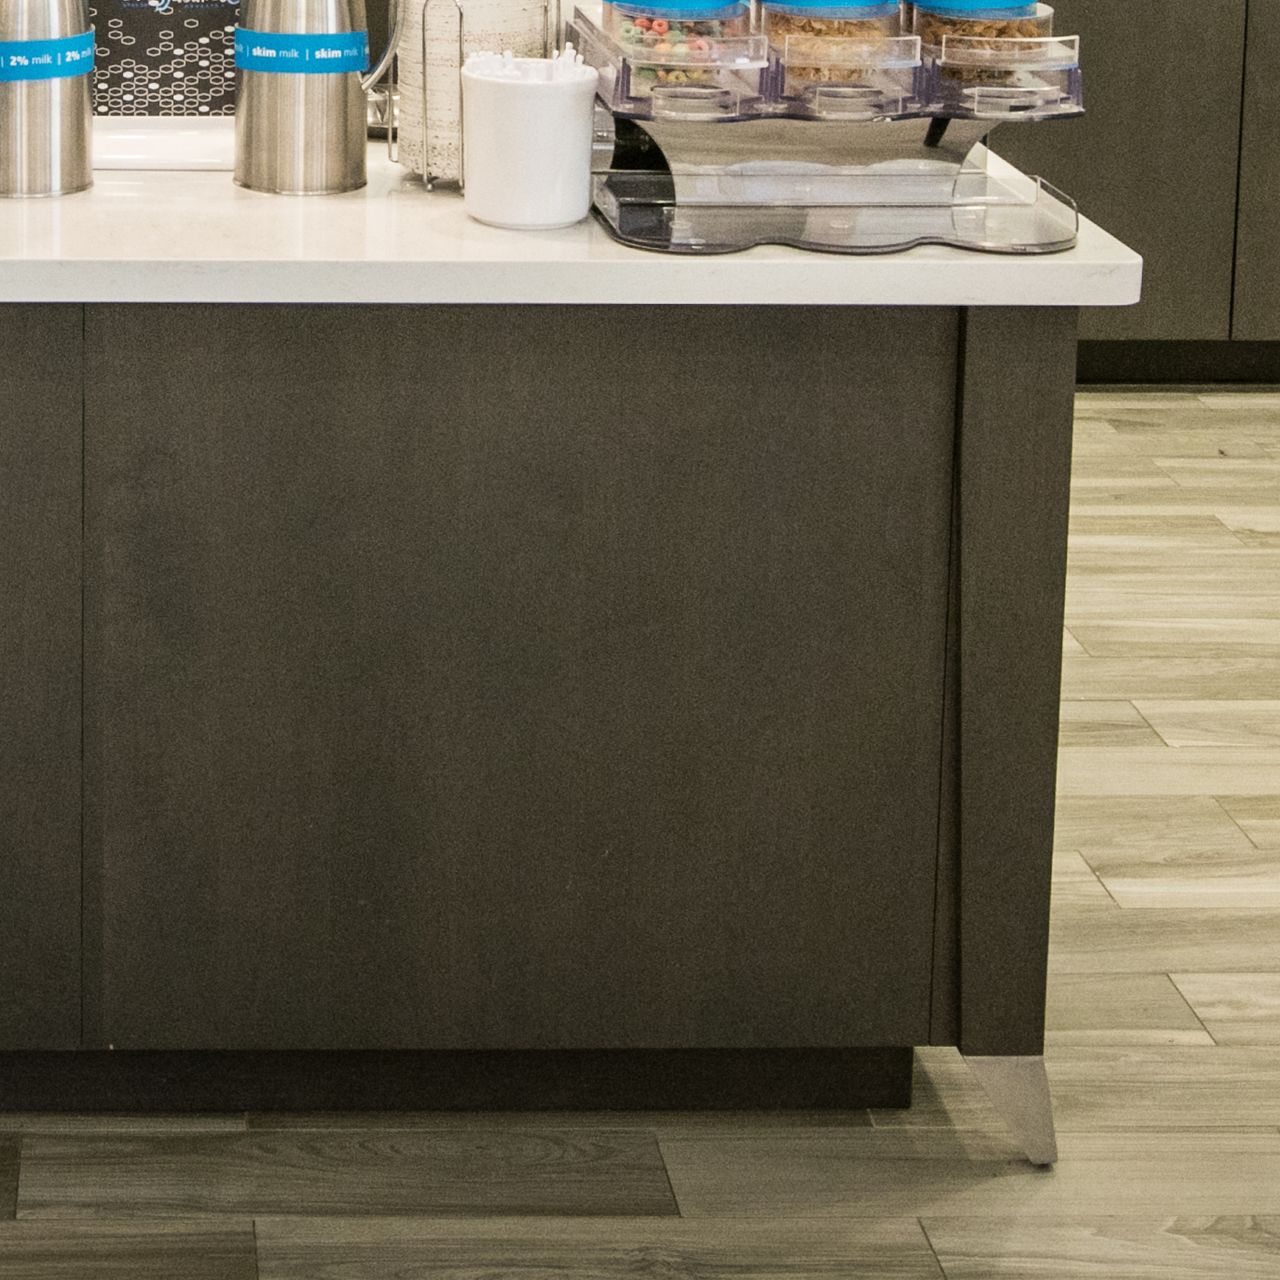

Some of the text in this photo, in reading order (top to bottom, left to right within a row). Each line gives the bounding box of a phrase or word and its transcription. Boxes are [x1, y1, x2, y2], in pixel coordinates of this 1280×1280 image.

[10, 55, 28, 66] 2%
[32, 54, 52, 64] milk
[65, 51, 80, 62] 2%
[252, 46, 276, 57] skim
[279, 48, 299, 59] milk
[315, 48, 342, 59] skim
[343, 48, 358, 57] milk
